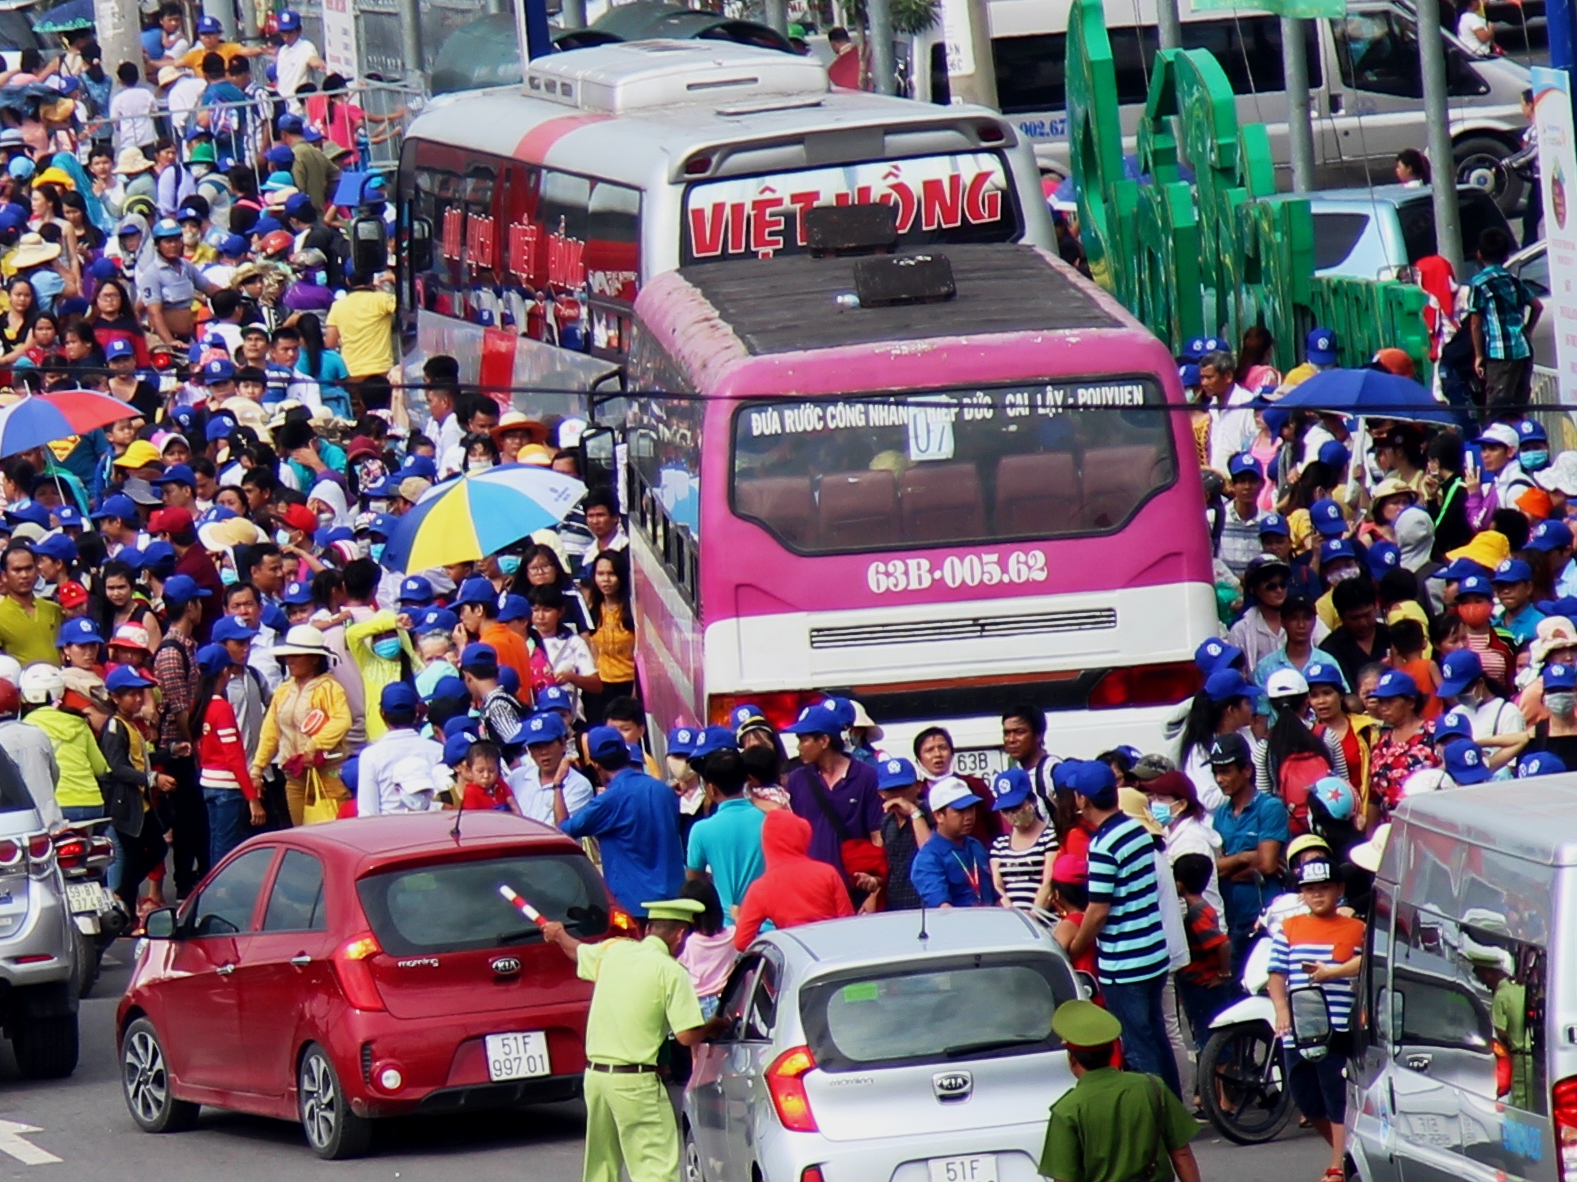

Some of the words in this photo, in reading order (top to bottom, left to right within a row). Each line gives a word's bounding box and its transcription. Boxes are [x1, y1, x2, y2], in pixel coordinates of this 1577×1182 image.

[689, 185, 808, 261] VIỆT
[751, 410, 782, 437] ĐƯA
[785, 405, 825, 433] RƯỚC
[826, 401, 867, 430] CÔNG
[868, 396, 909, 427] NHÂN
[956, 752, 988, 772] 63B
[494, 959, 519, 974] KIA
[500, 1034, 534, 1056] 51F
[490, 1052, 547, 1078] 997.01
[939, 1076, 966, 1091] KIA
[945, 1158, 981, 1181] 51F
